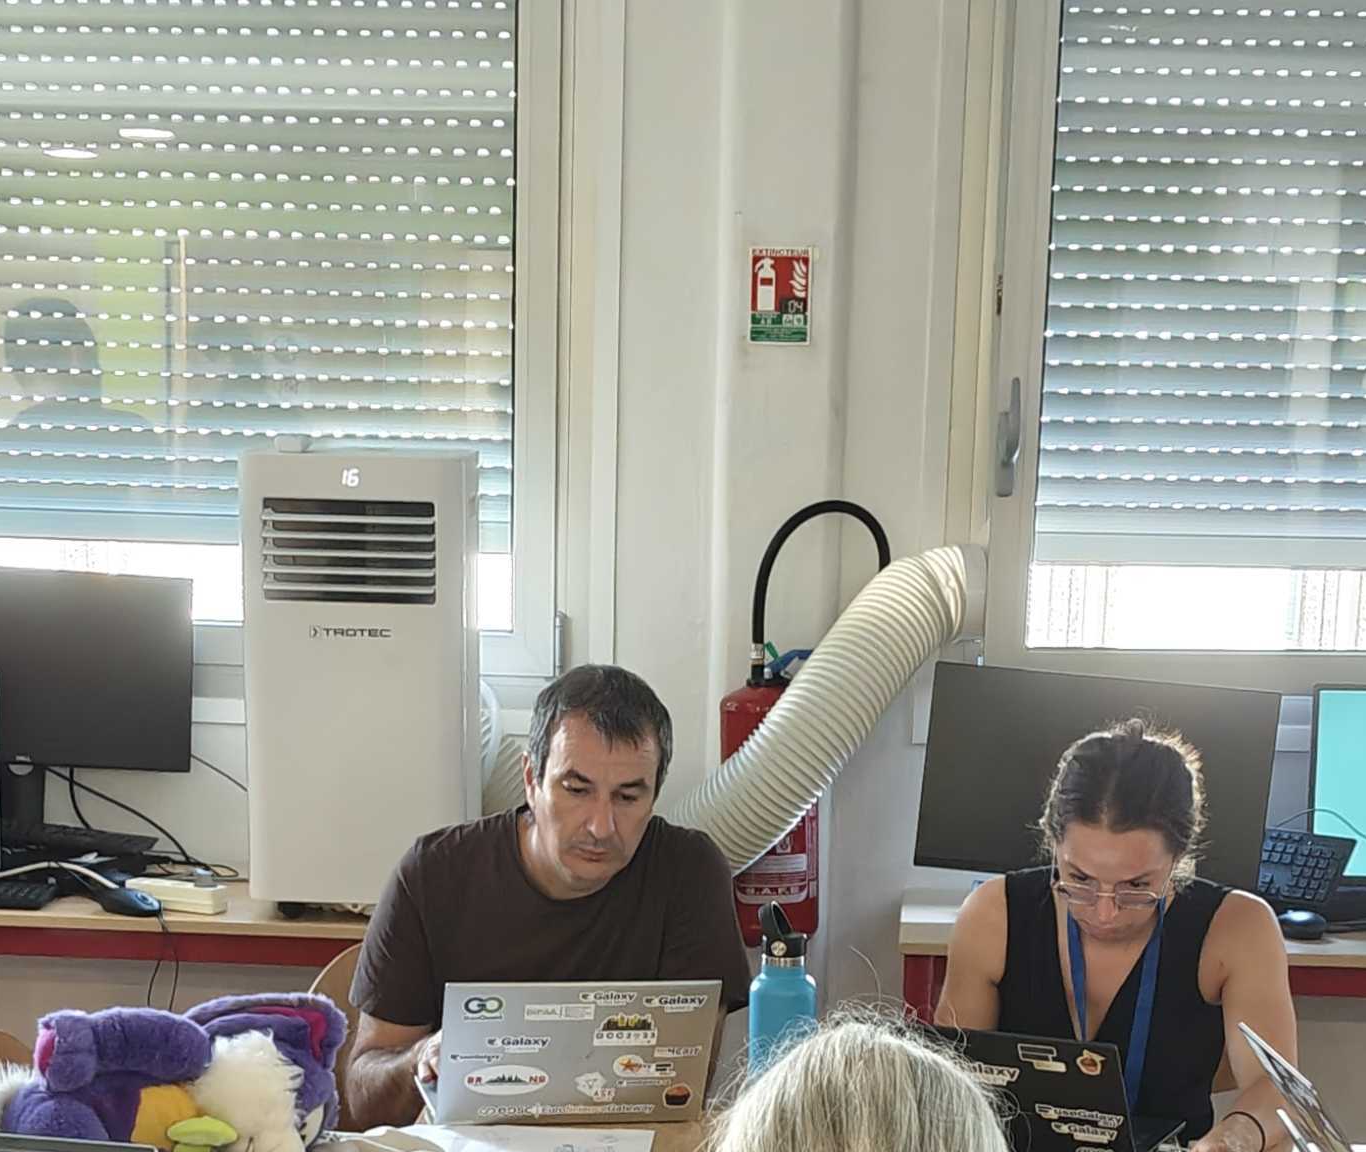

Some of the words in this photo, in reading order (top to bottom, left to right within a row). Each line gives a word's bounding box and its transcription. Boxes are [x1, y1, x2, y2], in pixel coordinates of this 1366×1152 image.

[342, 468, 359, 487] 16
[322, 627, 392, 638] TROTEC
[594, 991, 635, 1001] Galaxy
[658, 995, 705, 1006] Galaxy
[501, 1036, 549, 1047] Galaxy
[1068, 1125, 1117, 1138] Galaxy
